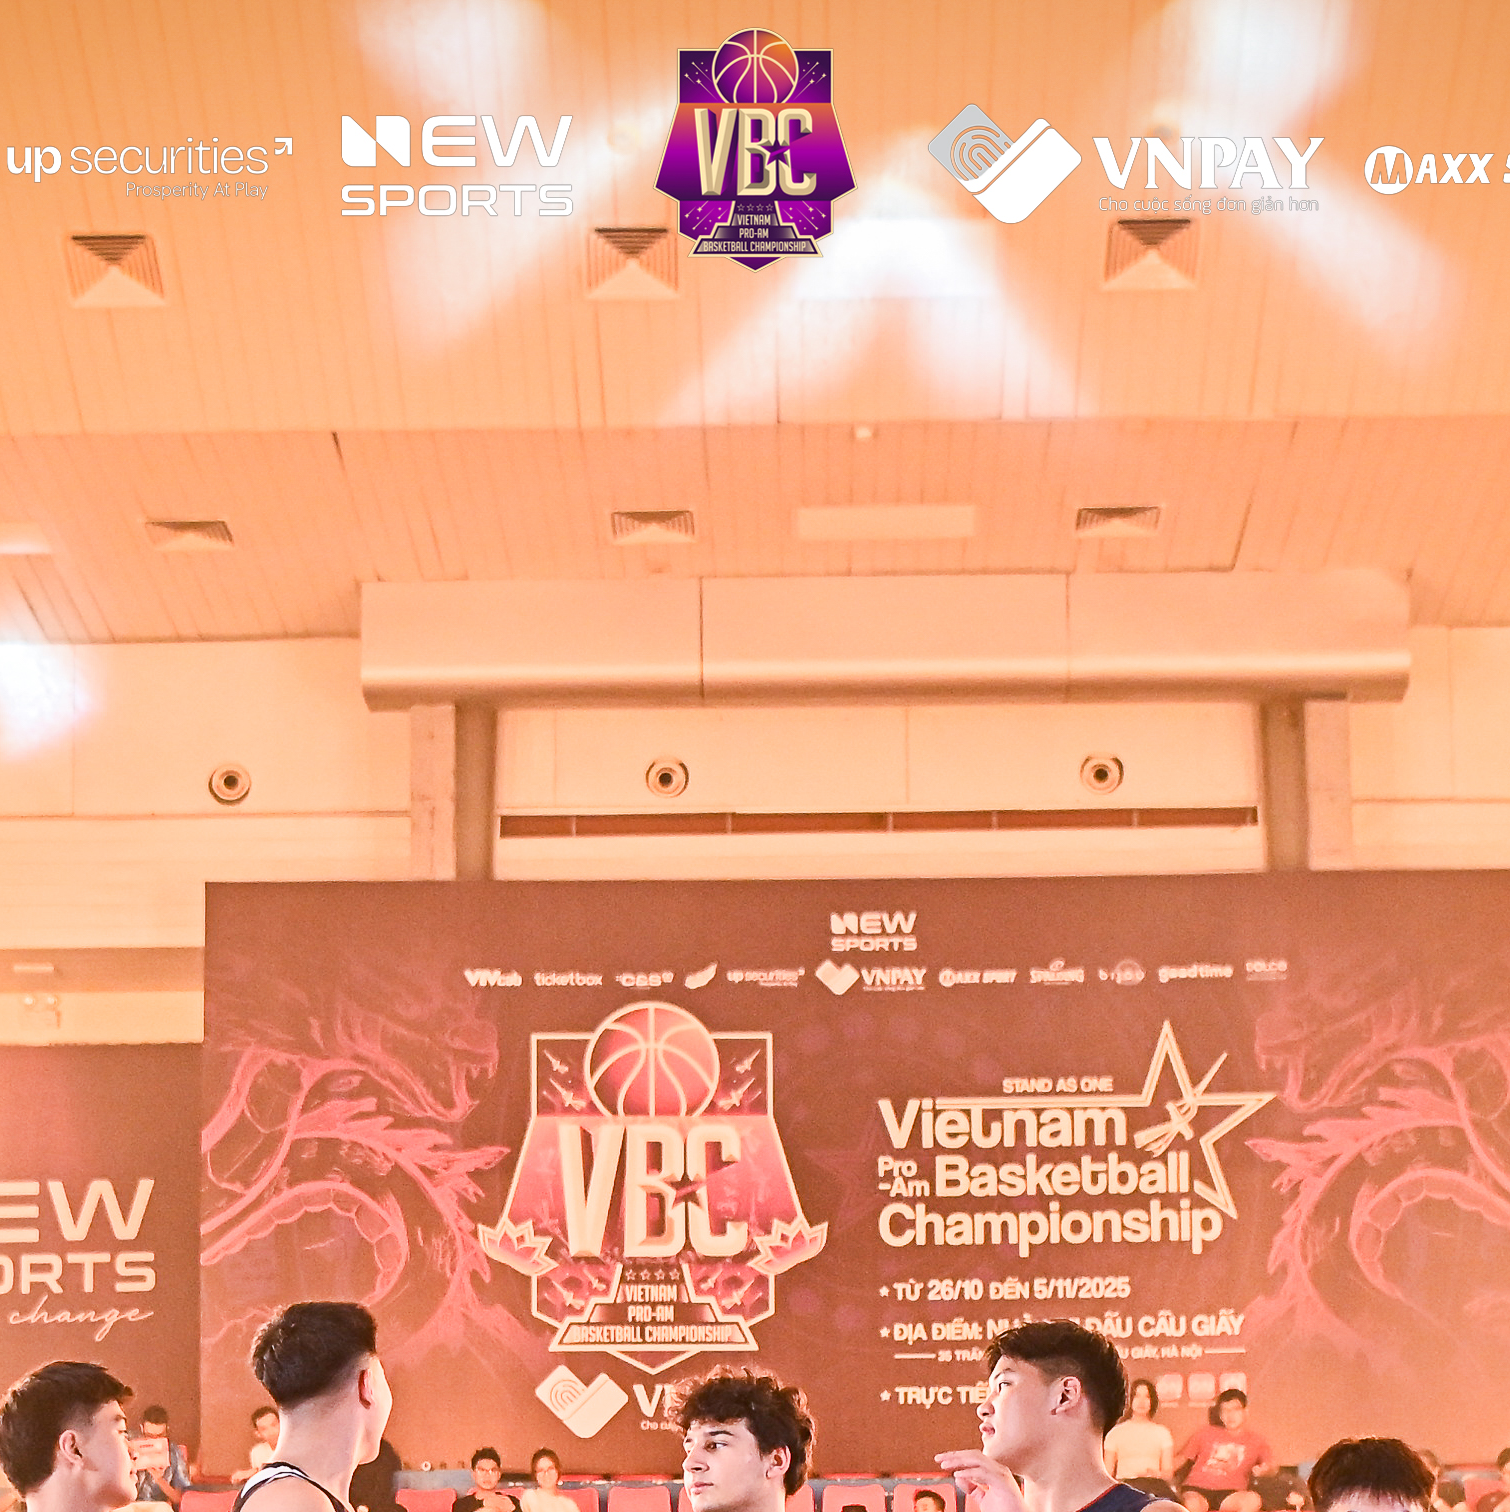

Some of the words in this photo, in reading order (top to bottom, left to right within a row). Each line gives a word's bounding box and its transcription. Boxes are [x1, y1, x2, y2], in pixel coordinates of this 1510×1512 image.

[830, 911, 917, 934] NEW
[831, 935, 918, 952] SPORTS
[860, 967, 927, 986] VNPAY
[1002, 1077, 1053, 1093] STAND
[1055, 1077, 1078, 1093] AS
[1079, 1075, 1114, 1092] ONE
[877, 1098, 1129, 1150] Vietnam
[877, 1155, 918, 1177] Pro
[935, 1150, 1190, 1197] Basketball
[557, 1123, 750, 1259] VBC
[878, 1198, 1224, 1258] Championship
[625, 1285, 678, 1302] VIETNAM
[927, 1277, 984, 1301] 26/10
[1032, 1274, 1131, 1300] 5/11/2025
[9, 1295, 154, 1342] change
[627, 1305, 675, 1323] PRO-AM
[573, 1324, 644, 1343] BASKETBALL
[644, 1323, 733, 1343] CHAMPIONSHIP
